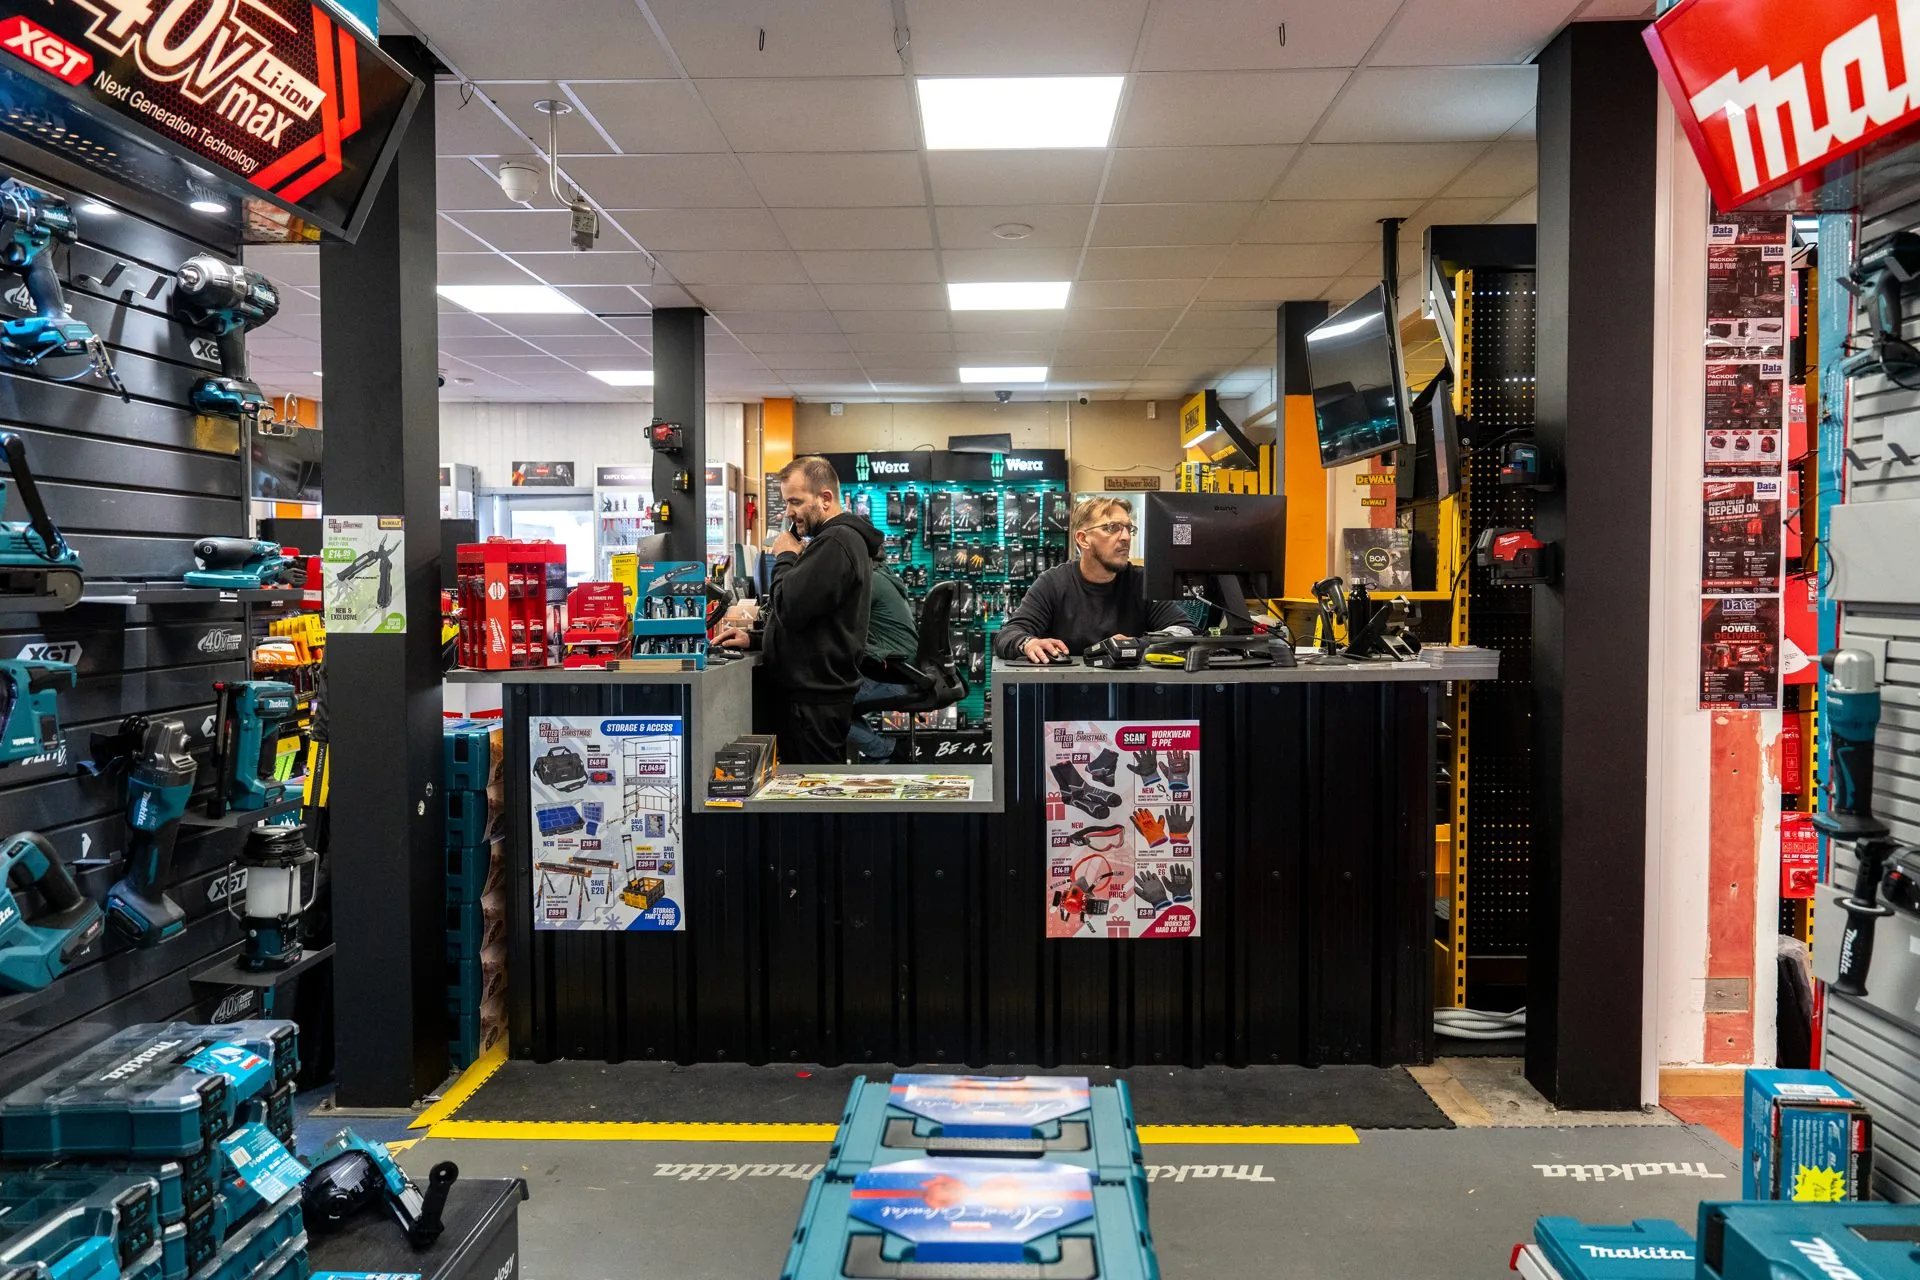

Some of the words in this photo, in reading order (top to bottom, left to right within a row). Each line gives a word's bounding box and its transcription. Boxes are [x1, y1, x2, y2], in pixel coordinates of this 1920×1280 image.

[4, 20, 89, 76] XGT
[217, 82, 294, 148] max
[94, 70, 131, 109] Next
[129, 91, 198, 139] Generation
[198, 126, 260, 174] Technology
[1712, 225, 1733, 234] Data
[1763, 246, 1784, 254] Data
[1761, 364, 1782, 372] Data
[871, 461, 910, 474] Wera
[1005, 458, 1044, 471] Wera
[1107, 479, 1123, 487] Data
[1757, 482, 1777, 490] Data
[1708, 504, 1745, 516] DEPEND
[1746, 502, 1761, 513] ON.
[1369, 554, 1387, 564] BOA
[1722, 599, 1756, 610] Data
[1721, 625, 1760, 633] POWER.
[27, 643, 79, 662] XGT
[606, 723, 639, 732] STORAGE
[639, 723, 645, 732] &
[646, 723, 674, 732] ACCESS
[1124, 733, 1146, 742] SCAN
[1151, 730, 1192, 739] WORKWEAR
[1151, 738, 1158, 747] &
[1158, 738, 1173, 747] PPE
[935, 741, 962, 757] BE
[963, 743, 977, 755] A
[982, 742, 992, 756] T
[591, 887, 605, 895] £20
[1109, 883, 1125, 891] HALF
[1108, 891, 1127, 899] PRICE
[1840, 928, 1858, 975] Makita
[1851, 1153, 1859, 1180] Cordless
[1144, 1164, 1276, 1182] Maki
[1532, 1162, 1727, 1182] Makita
[1580, 1245, 1695, 1261] Makita
